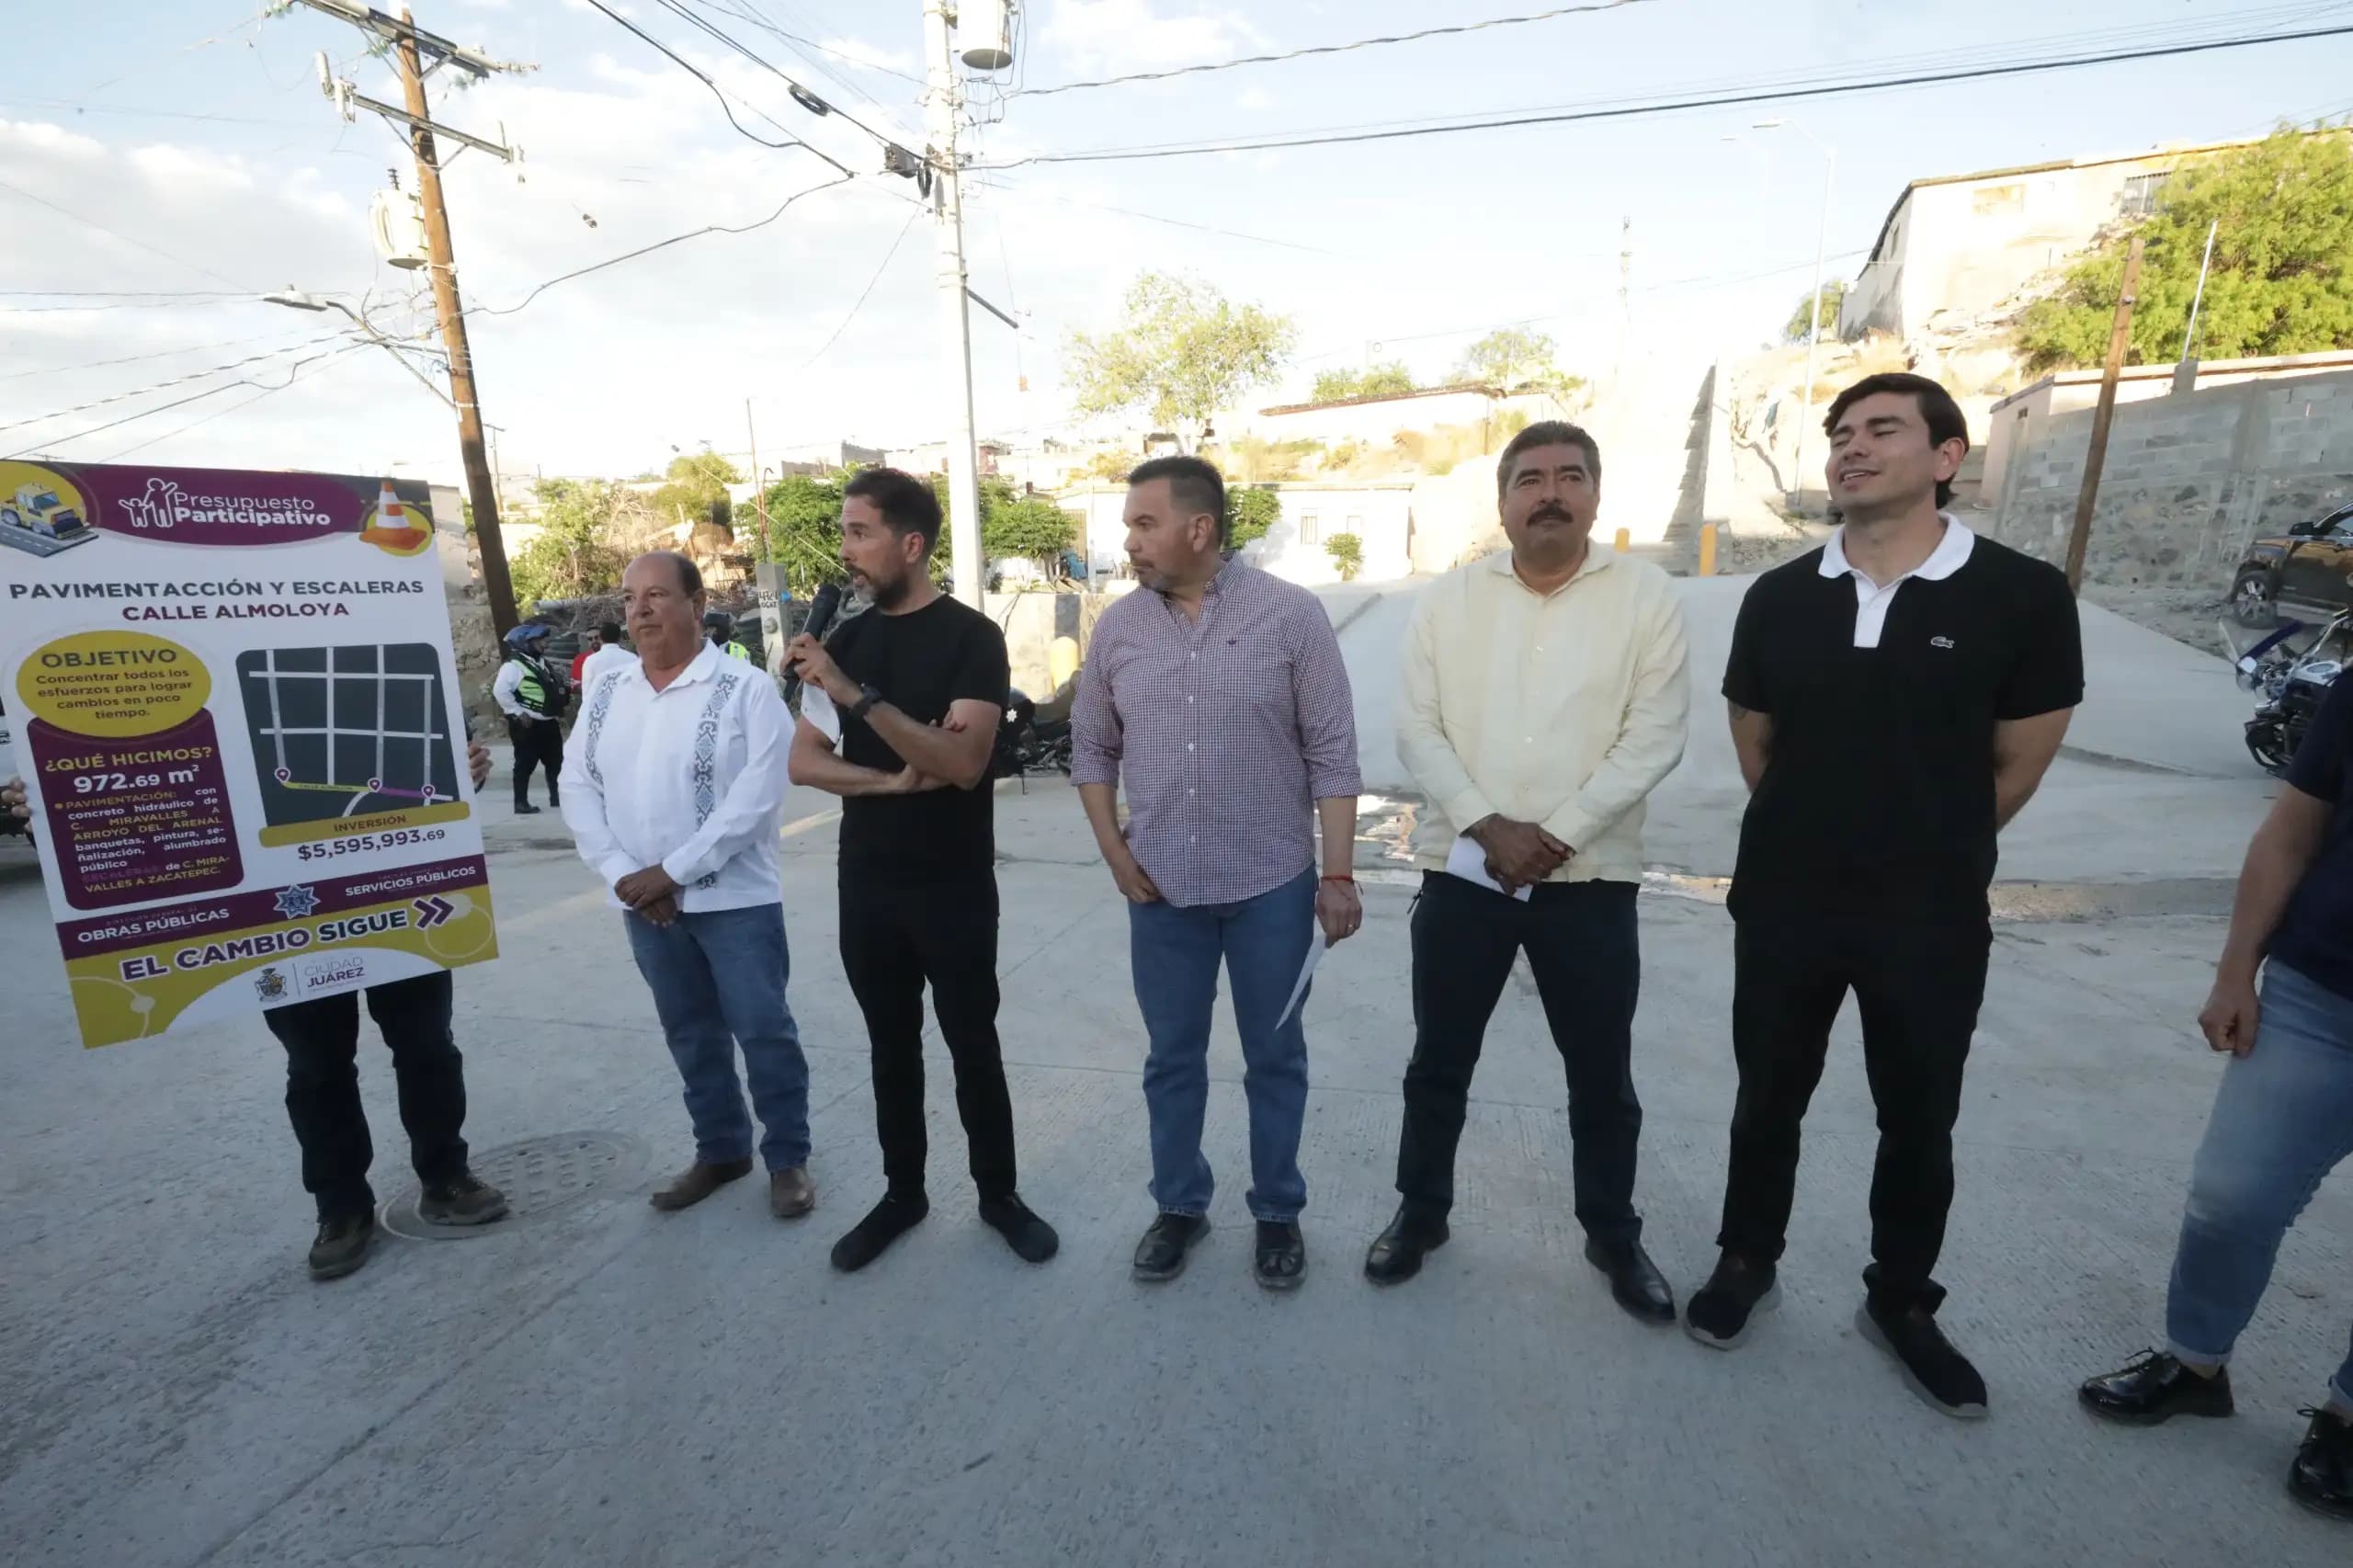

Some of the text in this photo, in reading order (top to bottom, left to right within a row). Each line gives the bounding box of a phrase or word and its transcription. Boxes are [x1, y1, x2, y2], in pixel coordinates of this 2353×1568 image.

[174, 492, 314, 512] Presupuesto
[173, 507, 331, 527] Participativo
[9, 579, 424, 599] PAVIMENTACCIÓN Y ESCALERAS
[122, 602, 349, 622] CALLE ALMOLOYA
[41, 649, 176, 668] OBJETIVO
[36, 669, 189, 685] Concentrar todos los
[38, 681, 192, 698] esfuerzos para lograr
[57, 694, 181, 710] cambios en poco
[95, 708, 151, 721] tiempo.
[45, 746, 212, 772] ¿QUÉ HICIMOS?
[74, 773, 160, 793] 972.69
[195, 788, 216, 796] con
[68, 797, 218, 820] concreto hidráulico de
[108, 810, 188, 826] MIRAVALLES
[74, 816, 222, 841] ARROYO DEL ARENAL
[75, 827, 224, 853] banquetas, pintura, se-
[164, 836, 226, 851] alumbrado
[298, 829, 445, 861] $5,595,993.69
[80, 859, 128, 874] público
[165, 862, 180, 871] de
[196, 856, 230, 867] MIRA-
[85, 879, 132, 892] VALLES
[137, 877, 146, 885] A
[345, 877, 414, 896] SERVICIOS
[416, 866, 476, 884] PÚBLICOS
[77, 924, 142, 942] OBRAS
[146, 908, 230, 931] PÚBLICAS
[120, 956, 169, 982] EL
[176, 929, 311, 969] CAMBIO
[319, 910, 407, 941] SIGUE
[304, 955, 363, 977] CIUDAD
[307, 967, 366, 988] JUÁREZ
